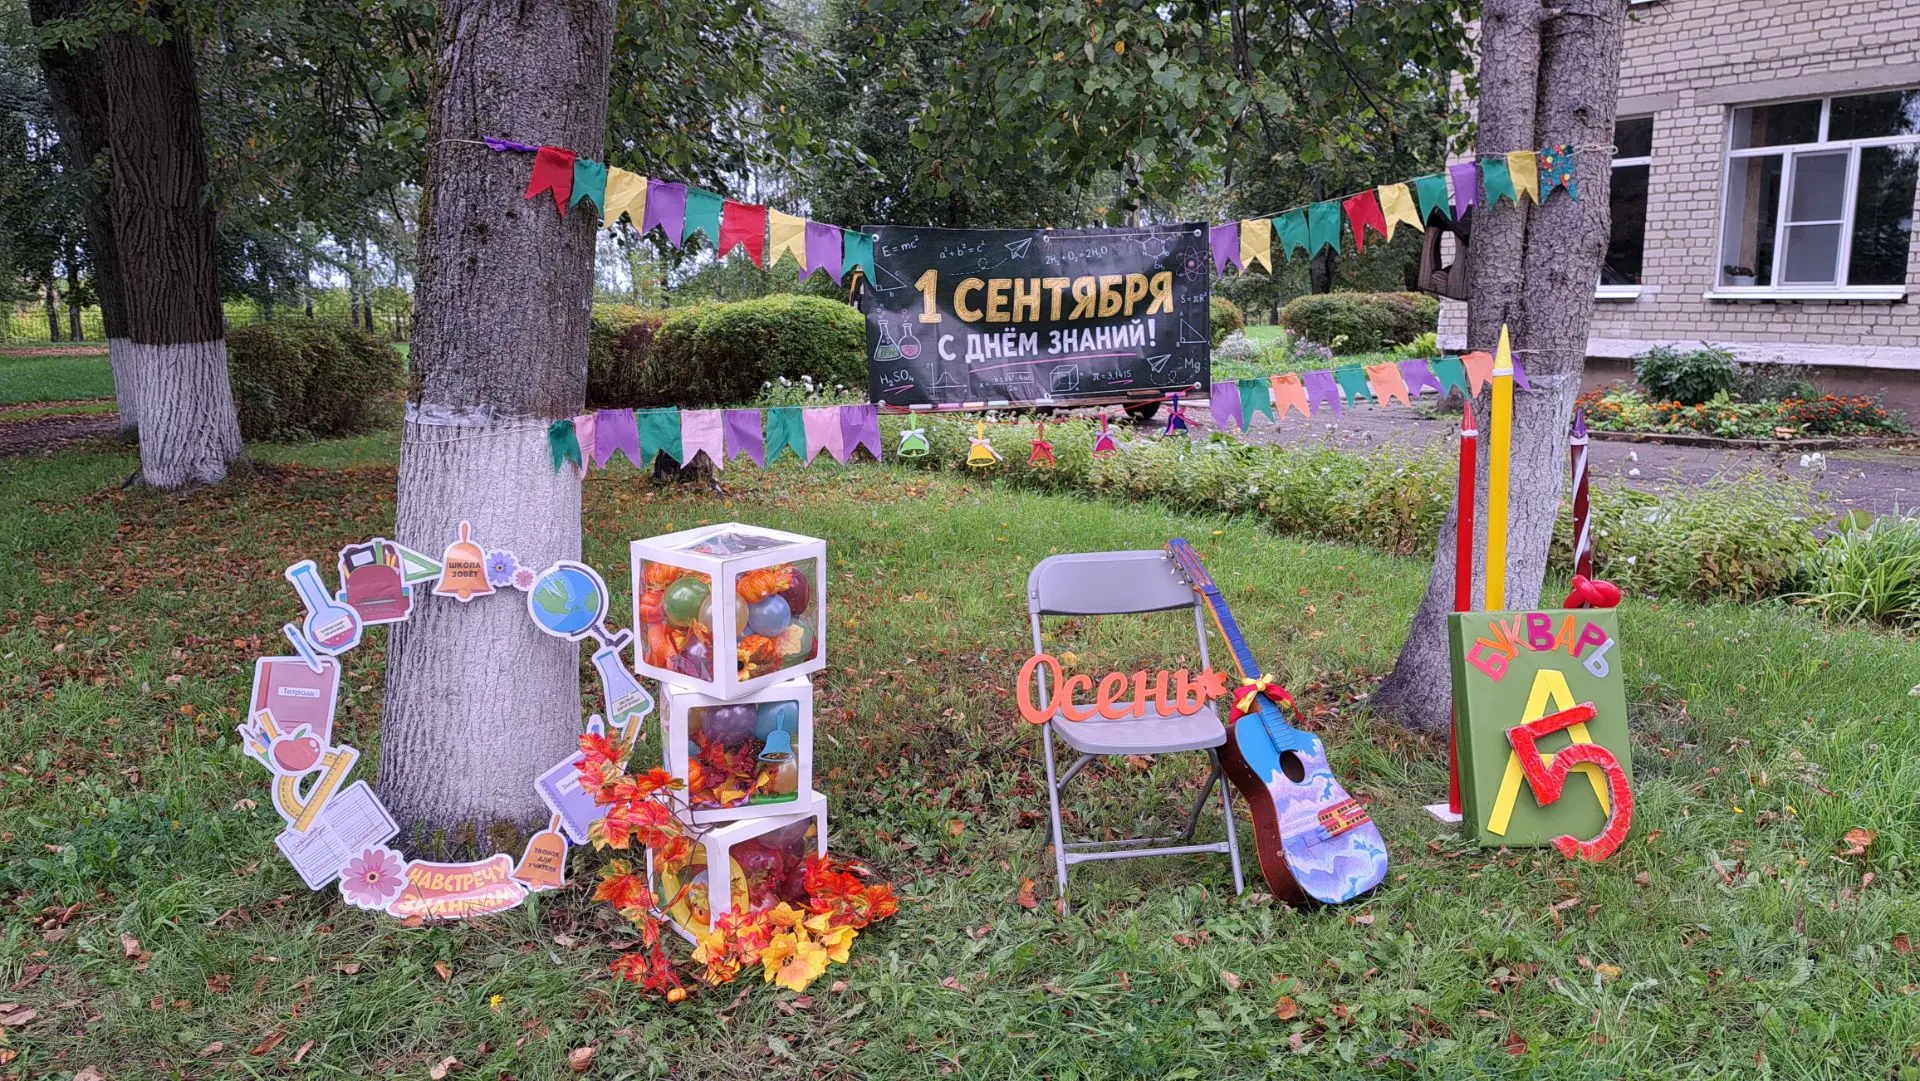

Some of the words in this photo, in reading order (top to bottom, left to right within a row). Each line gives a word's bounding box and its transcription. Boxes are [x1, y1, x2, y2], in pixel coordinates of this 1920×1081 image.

[914, 268, 942, 324] 1
[953, 271, 1174, 324] СЕНТЯБРЯ
[938, 334, 957, 361] С
[965, 327, 1039, 364] ДНЁМ
[1048, 318, 1156, 355] ЗНАНИЙ!
[1185, 358, 1201, 373] Mg
[448, 561, 481, 569] ШКОЛА
[1466, 612, 1616, 683] БУКВАРЬ
[1016, 653, 1207, 725] Осень
[1505, 701, 1634, 863] 5
[408, 861, 507, 892] НАВСТРЕЧУ
